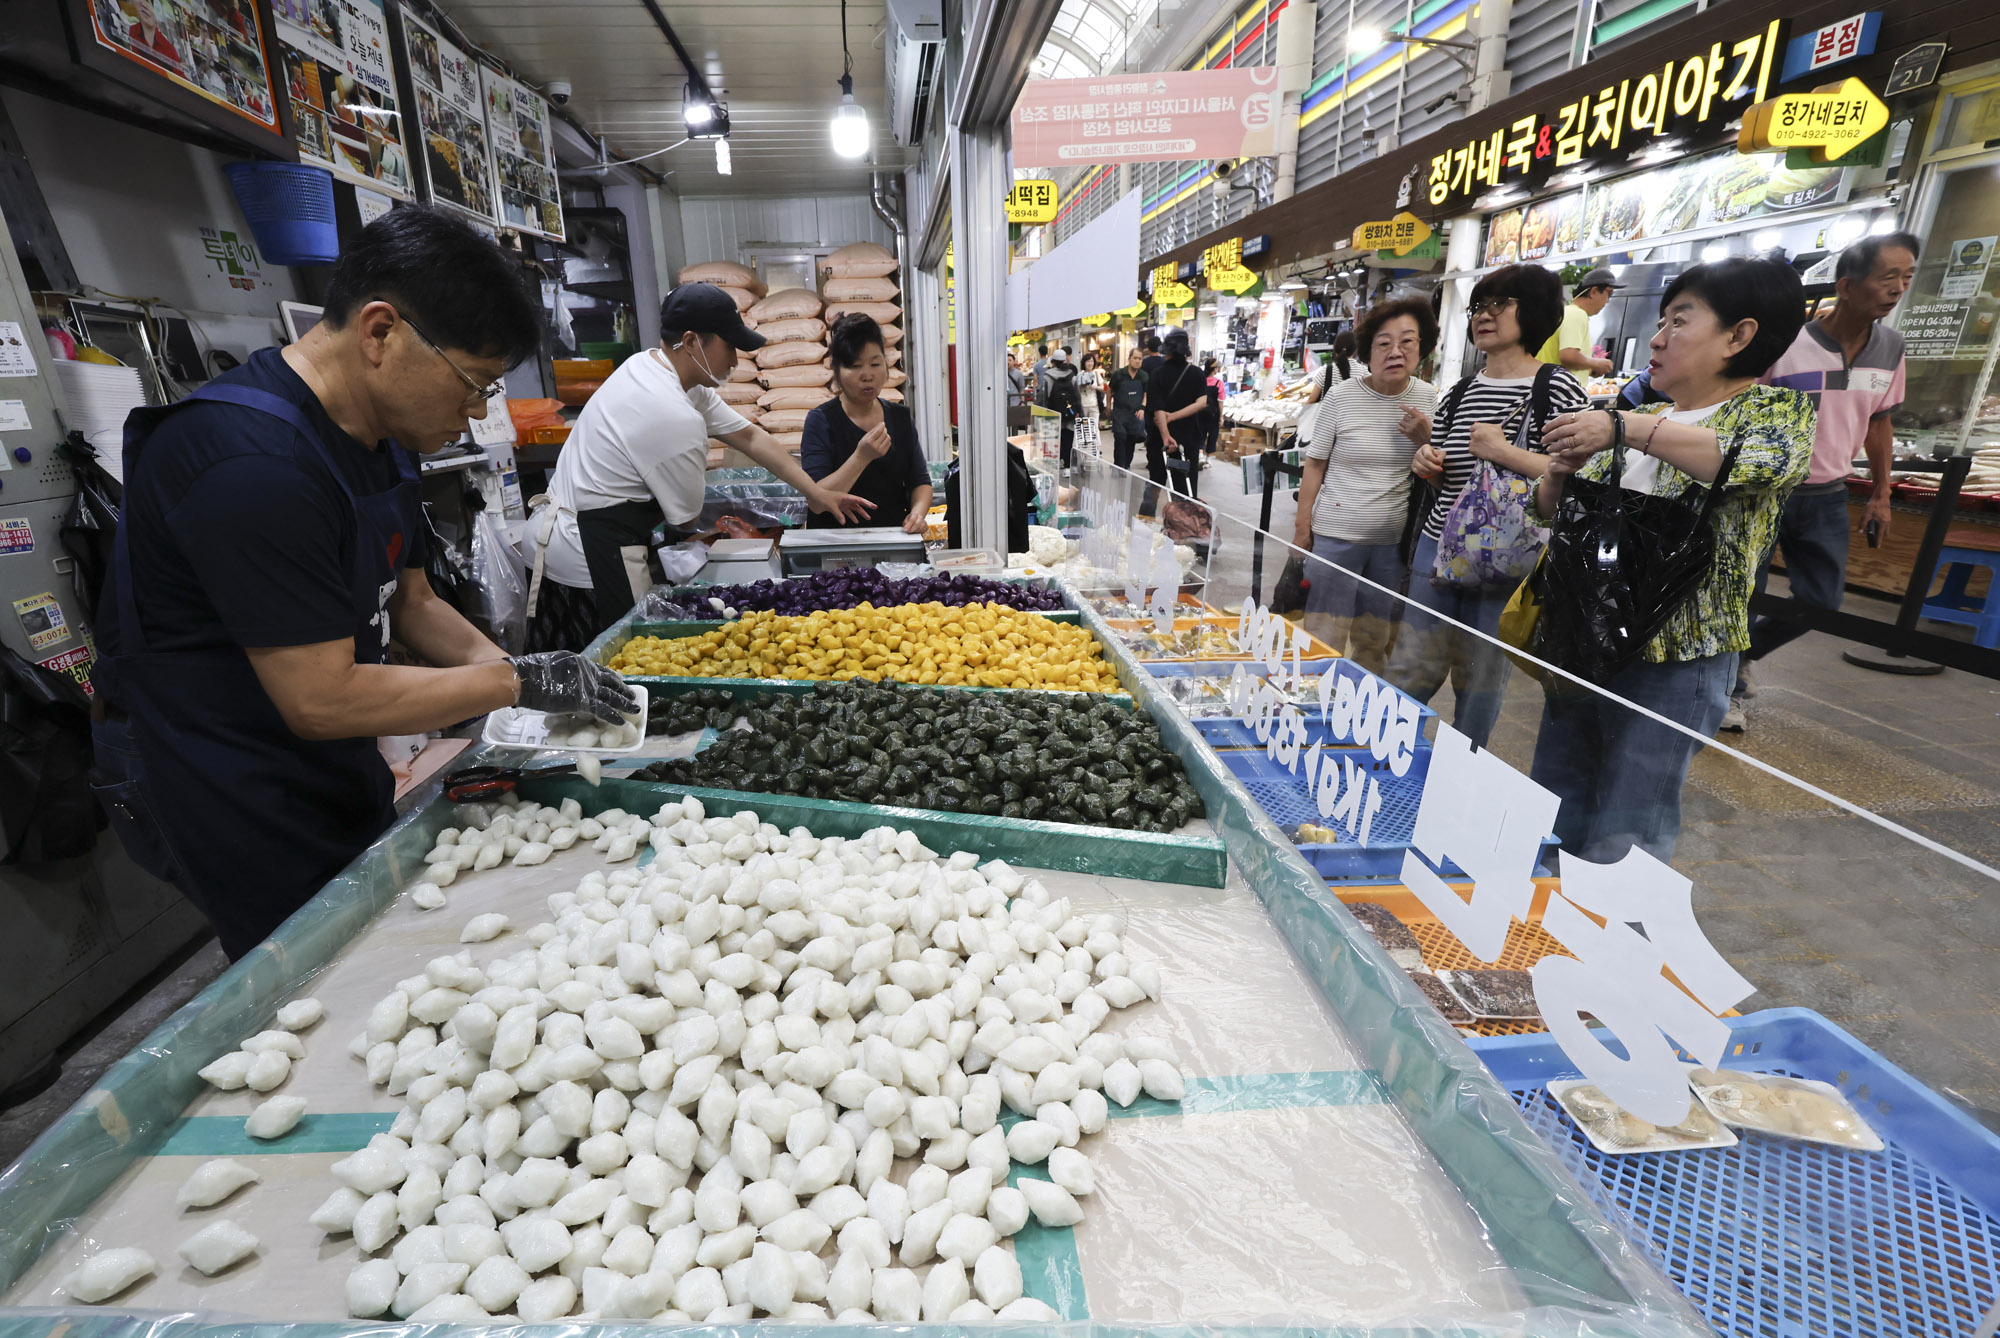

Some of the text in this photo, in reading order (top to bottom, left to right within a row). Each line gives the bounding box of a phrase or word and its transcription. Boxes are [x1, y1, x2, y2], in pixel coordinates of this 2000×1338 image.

[1815, 18, 1861, 65] 본점
[355, 64, 391, 94] 심가네떡집
[1900, 66, 1923, 87] 21
[1782, 100, 1868, 126] 정가네김치
[1776, 129, 1861, 139] 010-4922-3062
[1784, 189, 1816, 206] 백김치
[1707, 203, 1751, 221] 오이소박이
[1365, 222, 1415, 239] 쌍화차 전문
[1366, 238, 1414, 249] 010-8008-6881
[201, 232, 260, 273] 투데이
[1203, 237, 1239, 278] 동산건어물
[1215, 272, 1251, 284] 동산건어물
[1912, 303, 1959, 314] 영업시간안내
[1901, 318, 1926, 327] OPEN
[1926, 316, 1953, 326] 04:30
[1923, 328, 1949, 338] 05:20
[5, 520, 27, 529] 서비스
[0, 529, 30, 539] 68-1472
[32, 626, 69, 647] 63-0074
